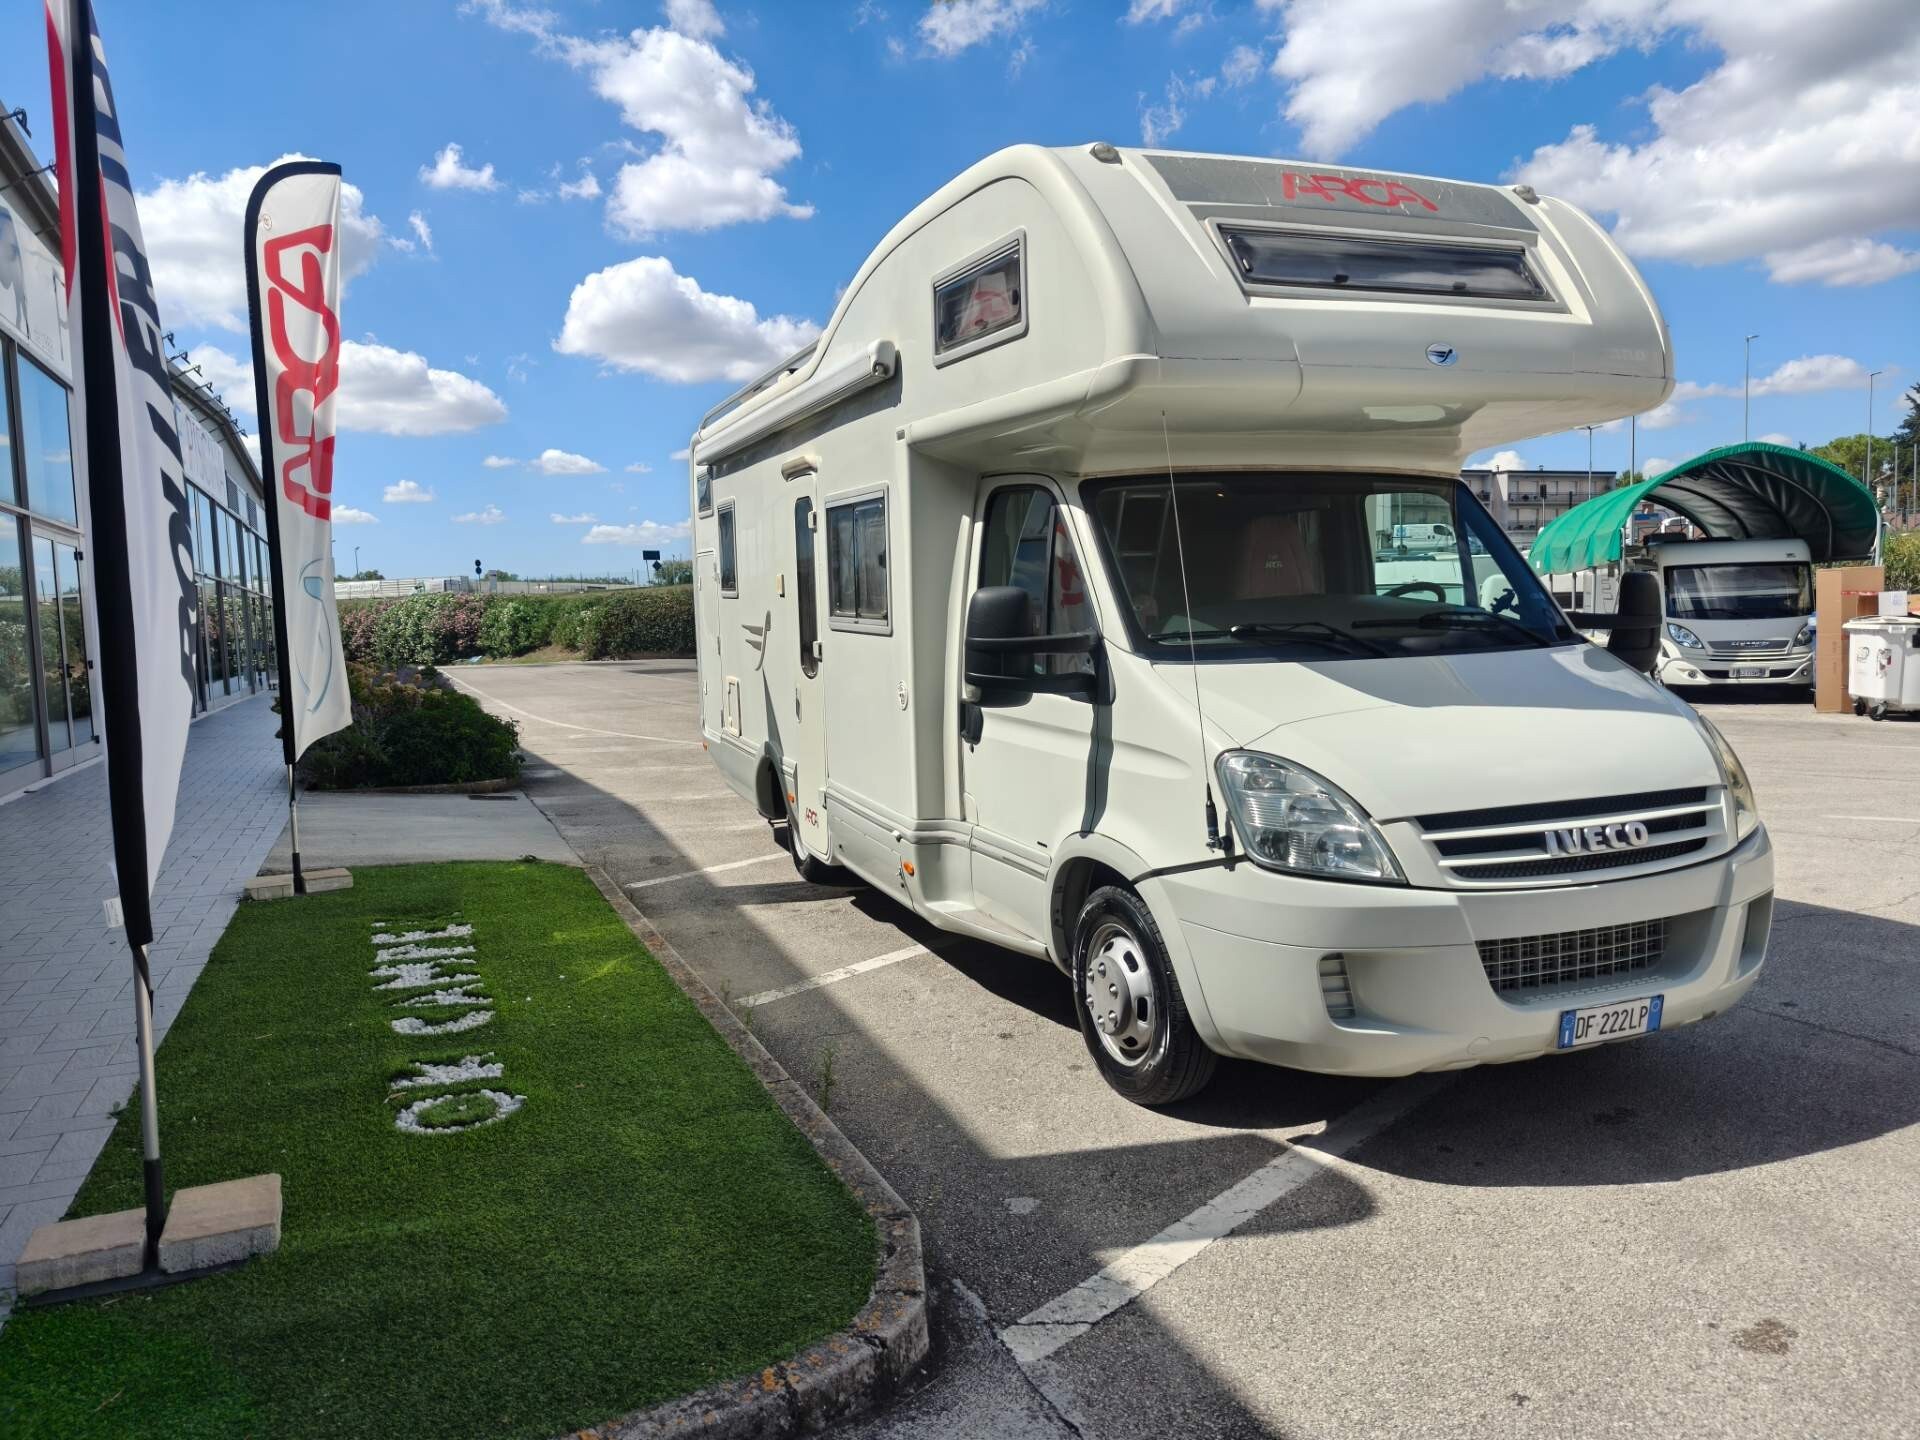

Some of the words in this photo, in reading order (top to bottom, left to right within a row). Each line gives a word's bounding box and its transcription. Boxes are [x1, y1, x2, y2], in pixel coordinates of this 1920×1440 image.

[1282, 173, 1439, 212] ARCA
[264, 224, 339, 521] ARCA
[1544, 821, 1649, 857] IVECO
[1574, 1014, 1597, 1040] DF
[1599, 1005, 1649, 1036] 222LP
